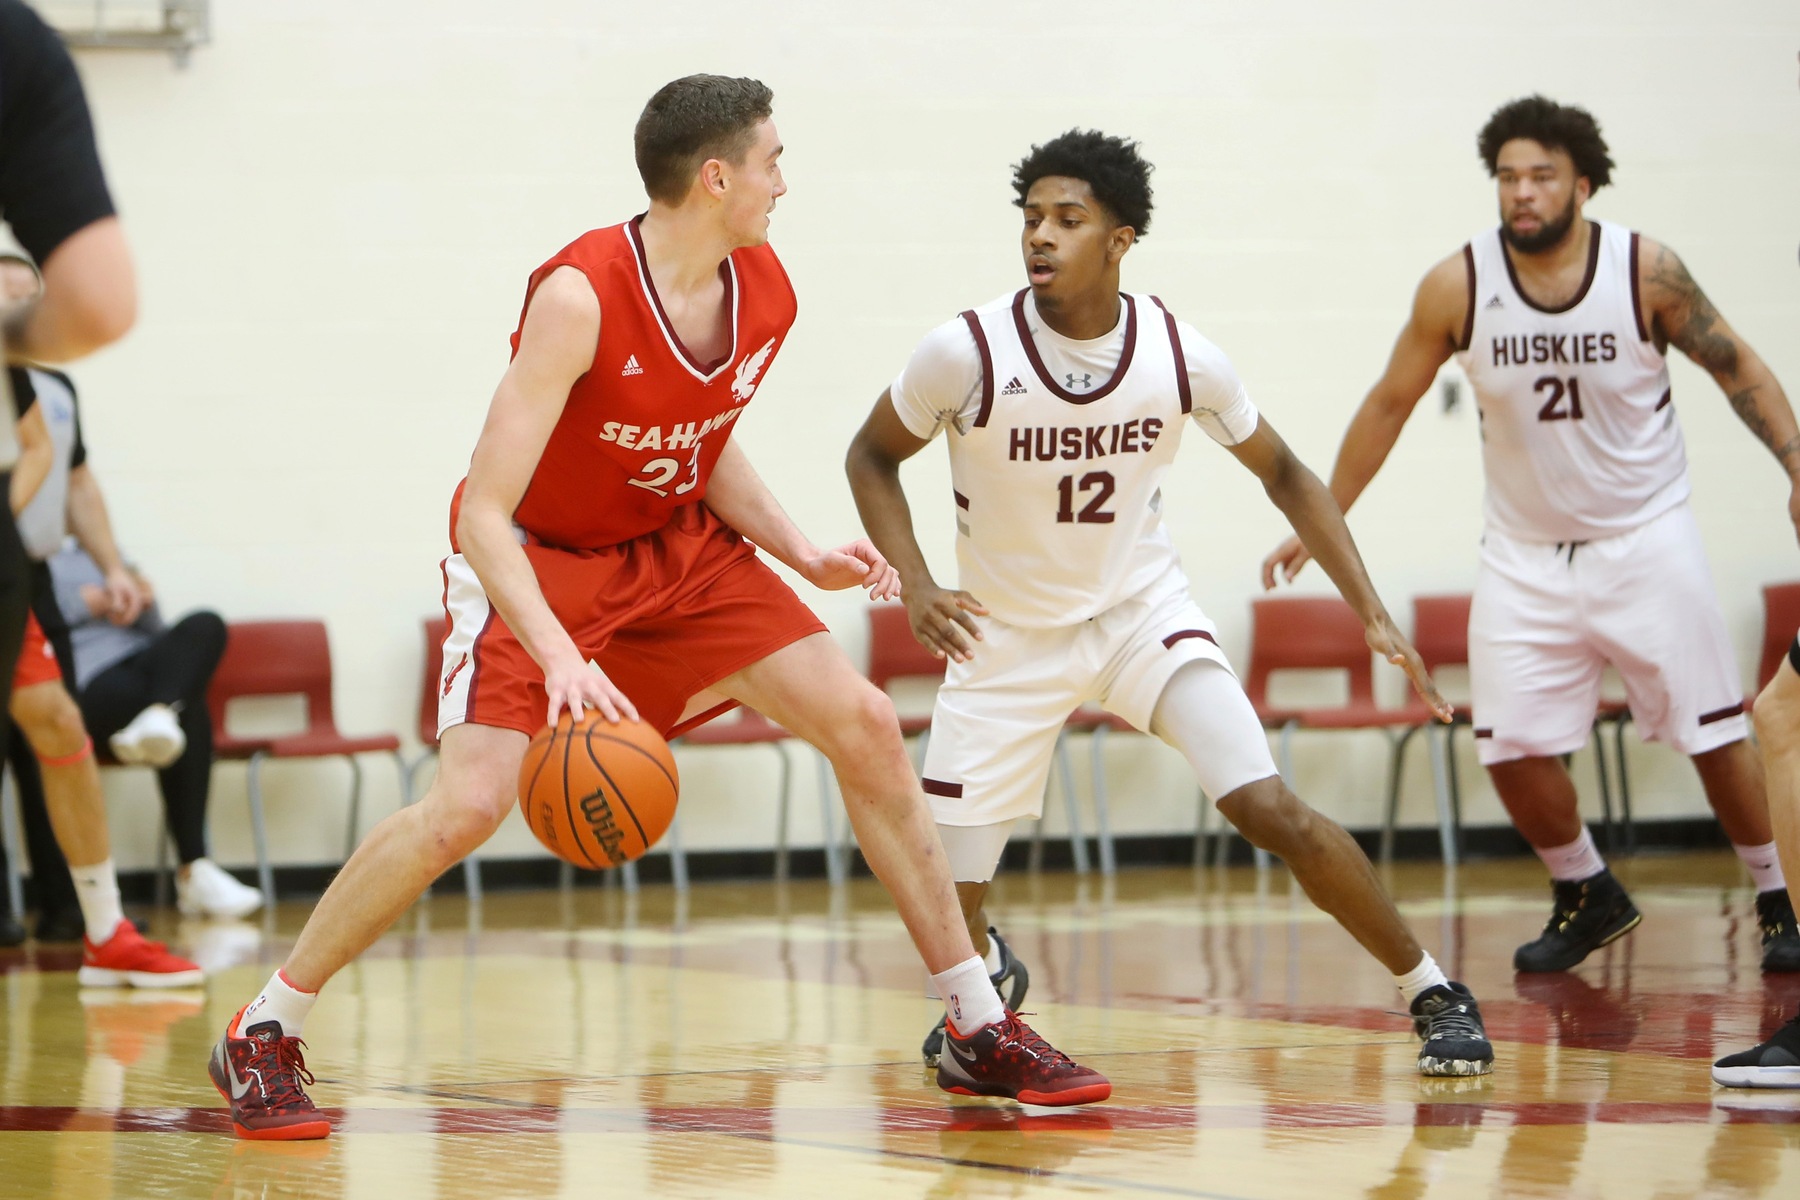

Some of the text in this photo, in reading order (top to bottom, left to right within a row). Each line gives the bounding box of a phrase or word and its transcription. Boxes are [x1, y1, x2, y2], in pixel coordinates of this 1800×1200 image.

[1492, 333, 1617, 366] HUSKIES
[621, 367, 644, 377] adidas
[1001, 387, 1028, 396] adidas
[1533, 376, 1584, 421] 21
[1009, 418, 1164, 461] HUSKIES
[627, 442, 702, 498] 23
[1056, 470, 1116, 524] 12
